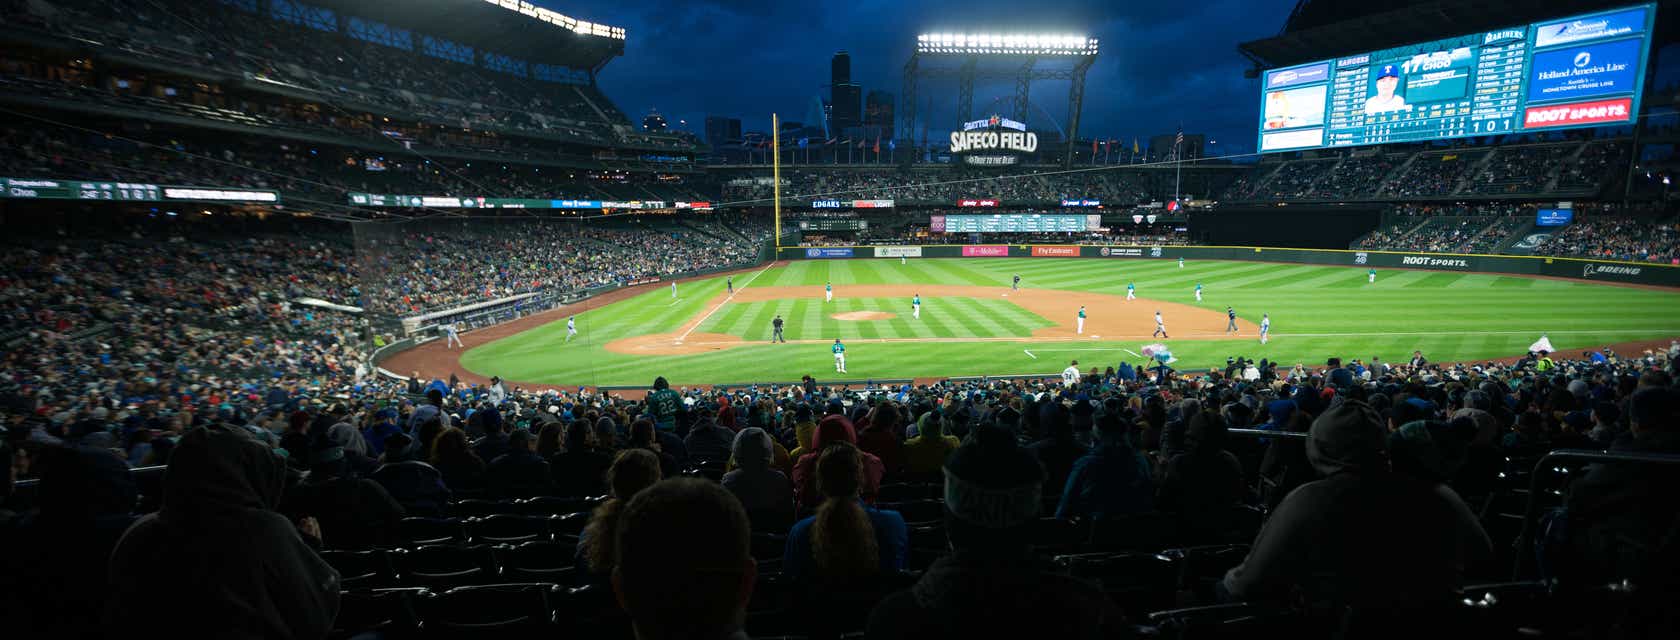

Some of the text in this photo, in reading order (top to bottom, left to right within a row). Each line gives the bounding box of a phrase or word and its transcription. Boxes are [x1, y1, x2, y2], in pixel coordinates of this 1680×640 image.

[1401, 58, 1421, 74] 17
[1422, 60, 1451, 71] CHOO
[1538, 62, 1626, 80] Holland America Line
[1527, 108, 1570, 123] ROOT
[1486, 120, 1496, 130] 0
[950, 131, 1037, 152] SAFECO FIELD
[1038, 247, 1048, 255] Fly
[1402, 256, 1430, 265] ROOT
[1597, 265, 1641, 275] BOEING
[659, 400, 677, 415] 22
